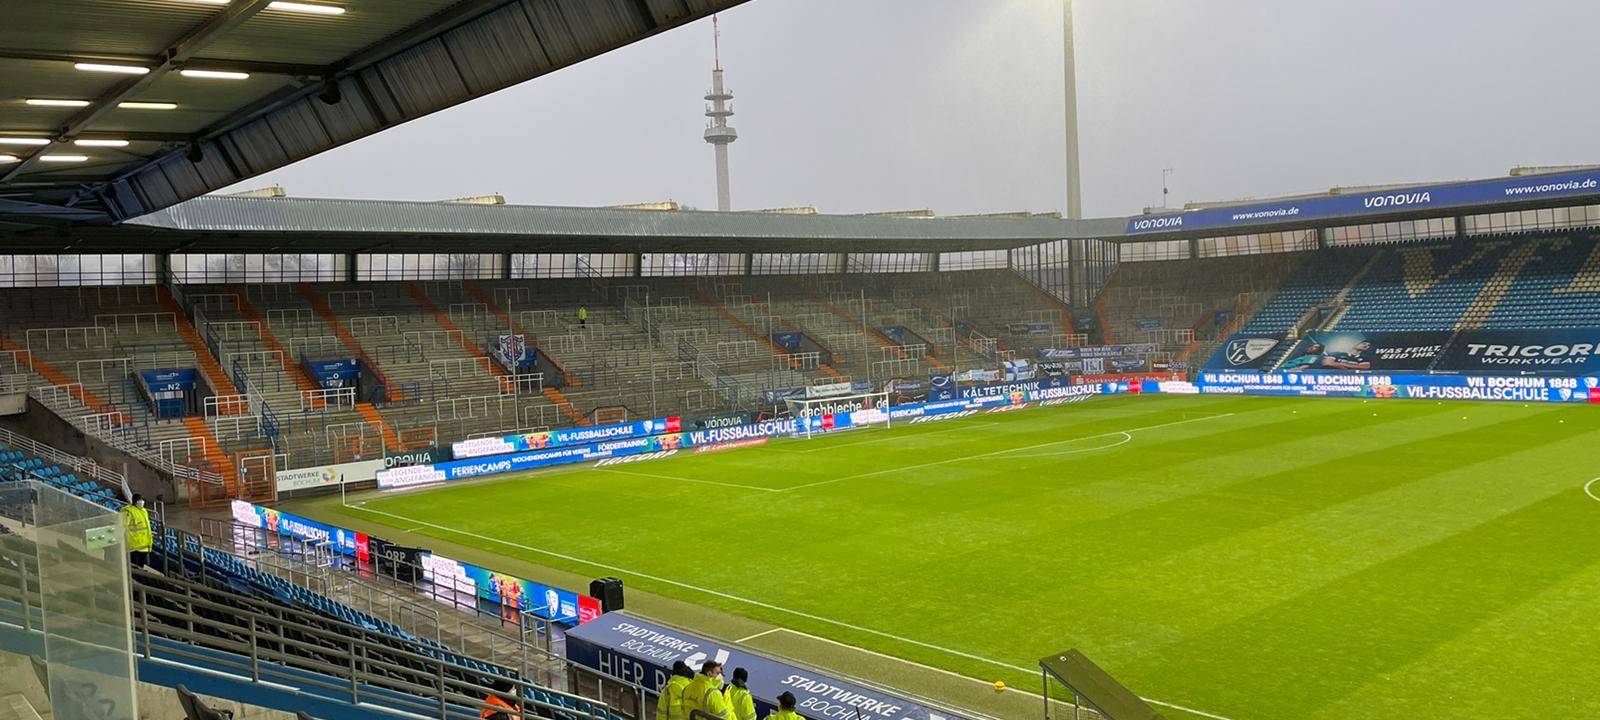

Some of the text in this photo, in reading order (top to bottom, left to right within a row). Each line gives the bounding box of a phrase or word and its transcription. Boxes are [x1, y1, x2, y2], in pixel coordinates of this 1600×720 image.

[1505, 179, 1597, 195] www.vonovia.de
[1232, 206, 1299, 221] www.vonovia.de
[1481, 357, 1587, 365] WORKWEAR
[167, 383, 180, 391] N2
[1219, 374, 1260, 384] BOCHUM
[1263, 374, 1283, 384] 1848
[1317, 375, 1365, 386] BOCHUM
[1367, 376, 1392, 386] 1848
[1489, 377, 1546, 388] BOCHUM
[1549, 379, 1578, 389] 1848
[963, 382, 1040, 398] KÄLTETECHNIK
[690, 419, 798, 444] VfL-FUSSBALLSCHULE
[276, 471, 320, 481] STADTWERKE
[452, 461, 511, 477] FERIENCAMPS
[612, 622, 699, 653] STADTWERKE
[620, 639, 680, 662] BOCHUM
[599, 650, 645, 687] HIER
[781, 674, 902, 717] STADTWERKE
